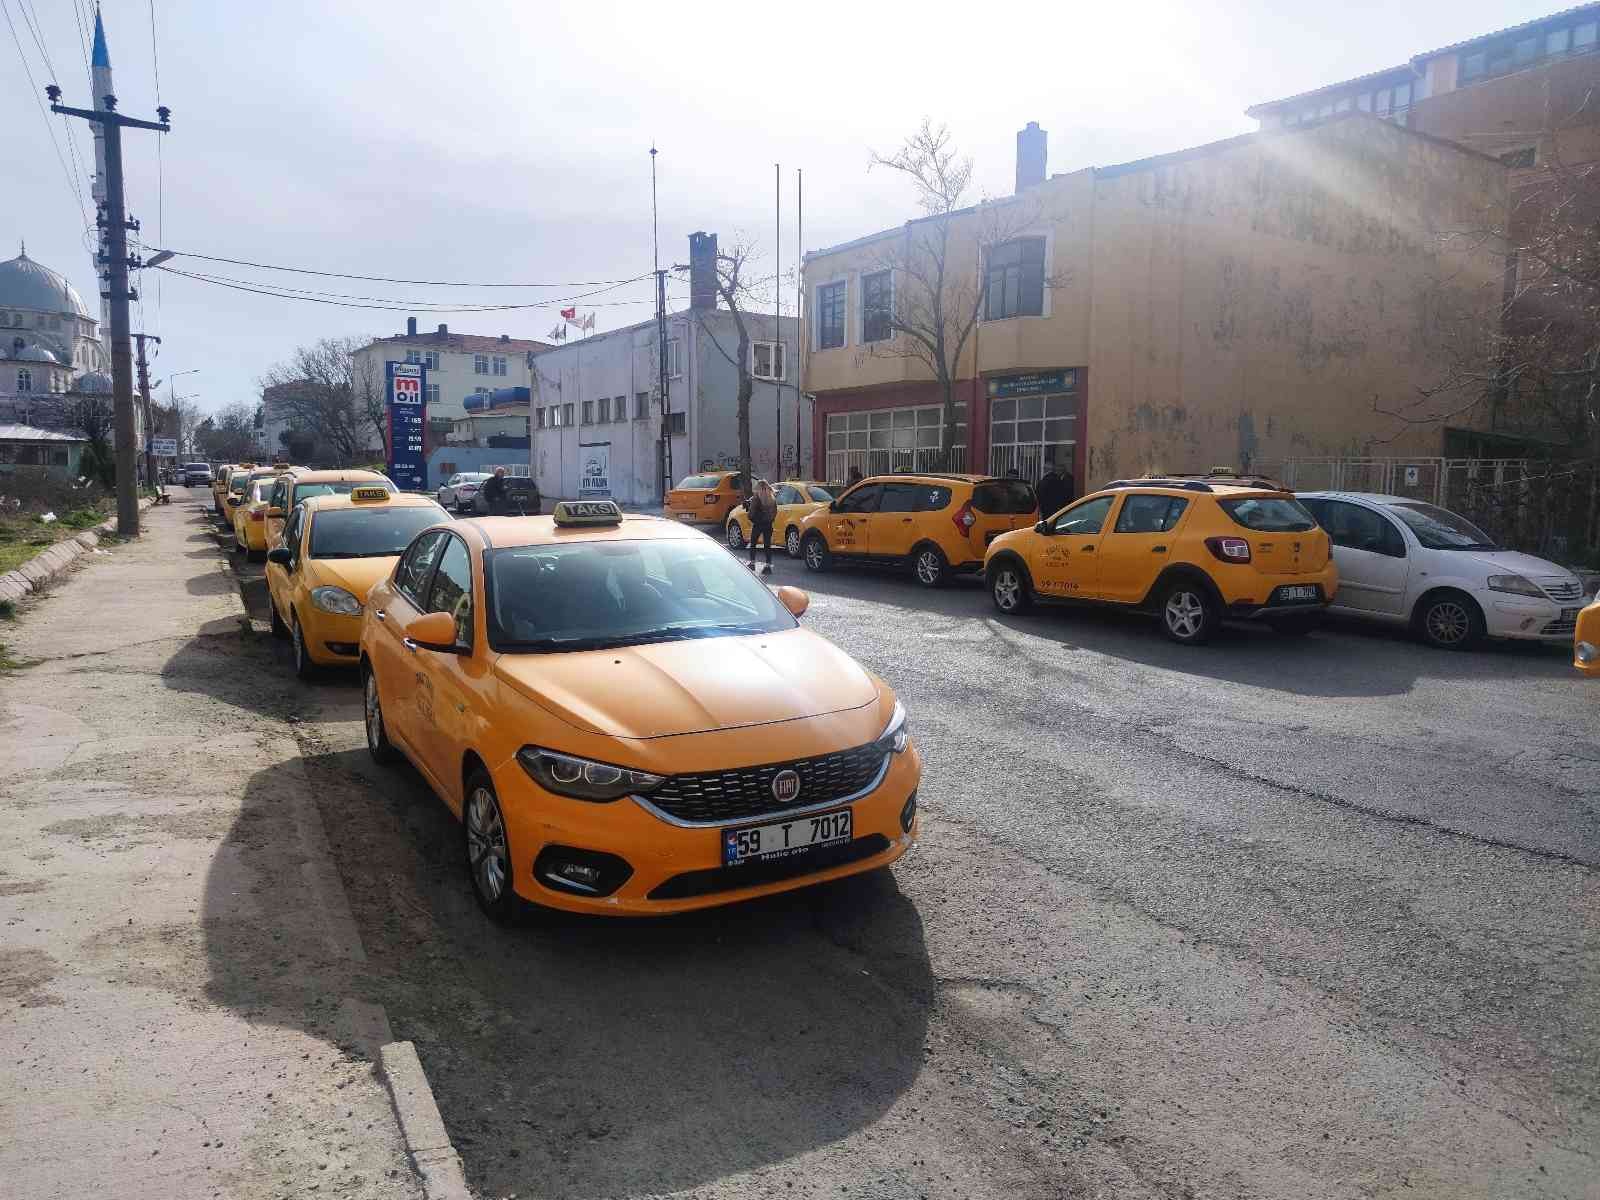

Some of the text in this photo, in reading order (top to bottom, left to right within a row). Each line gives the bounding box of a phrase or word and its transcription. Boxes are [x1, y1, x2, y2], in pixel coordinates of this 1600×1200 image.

[396, 378, 419, 391] m
[359, 489, 386, 498] TAKSI
[566, 503, 616, 515] TAKSI
[778, 778, 796, 795] FIAT
[737, 812, 850, 857] 59 T 7012
